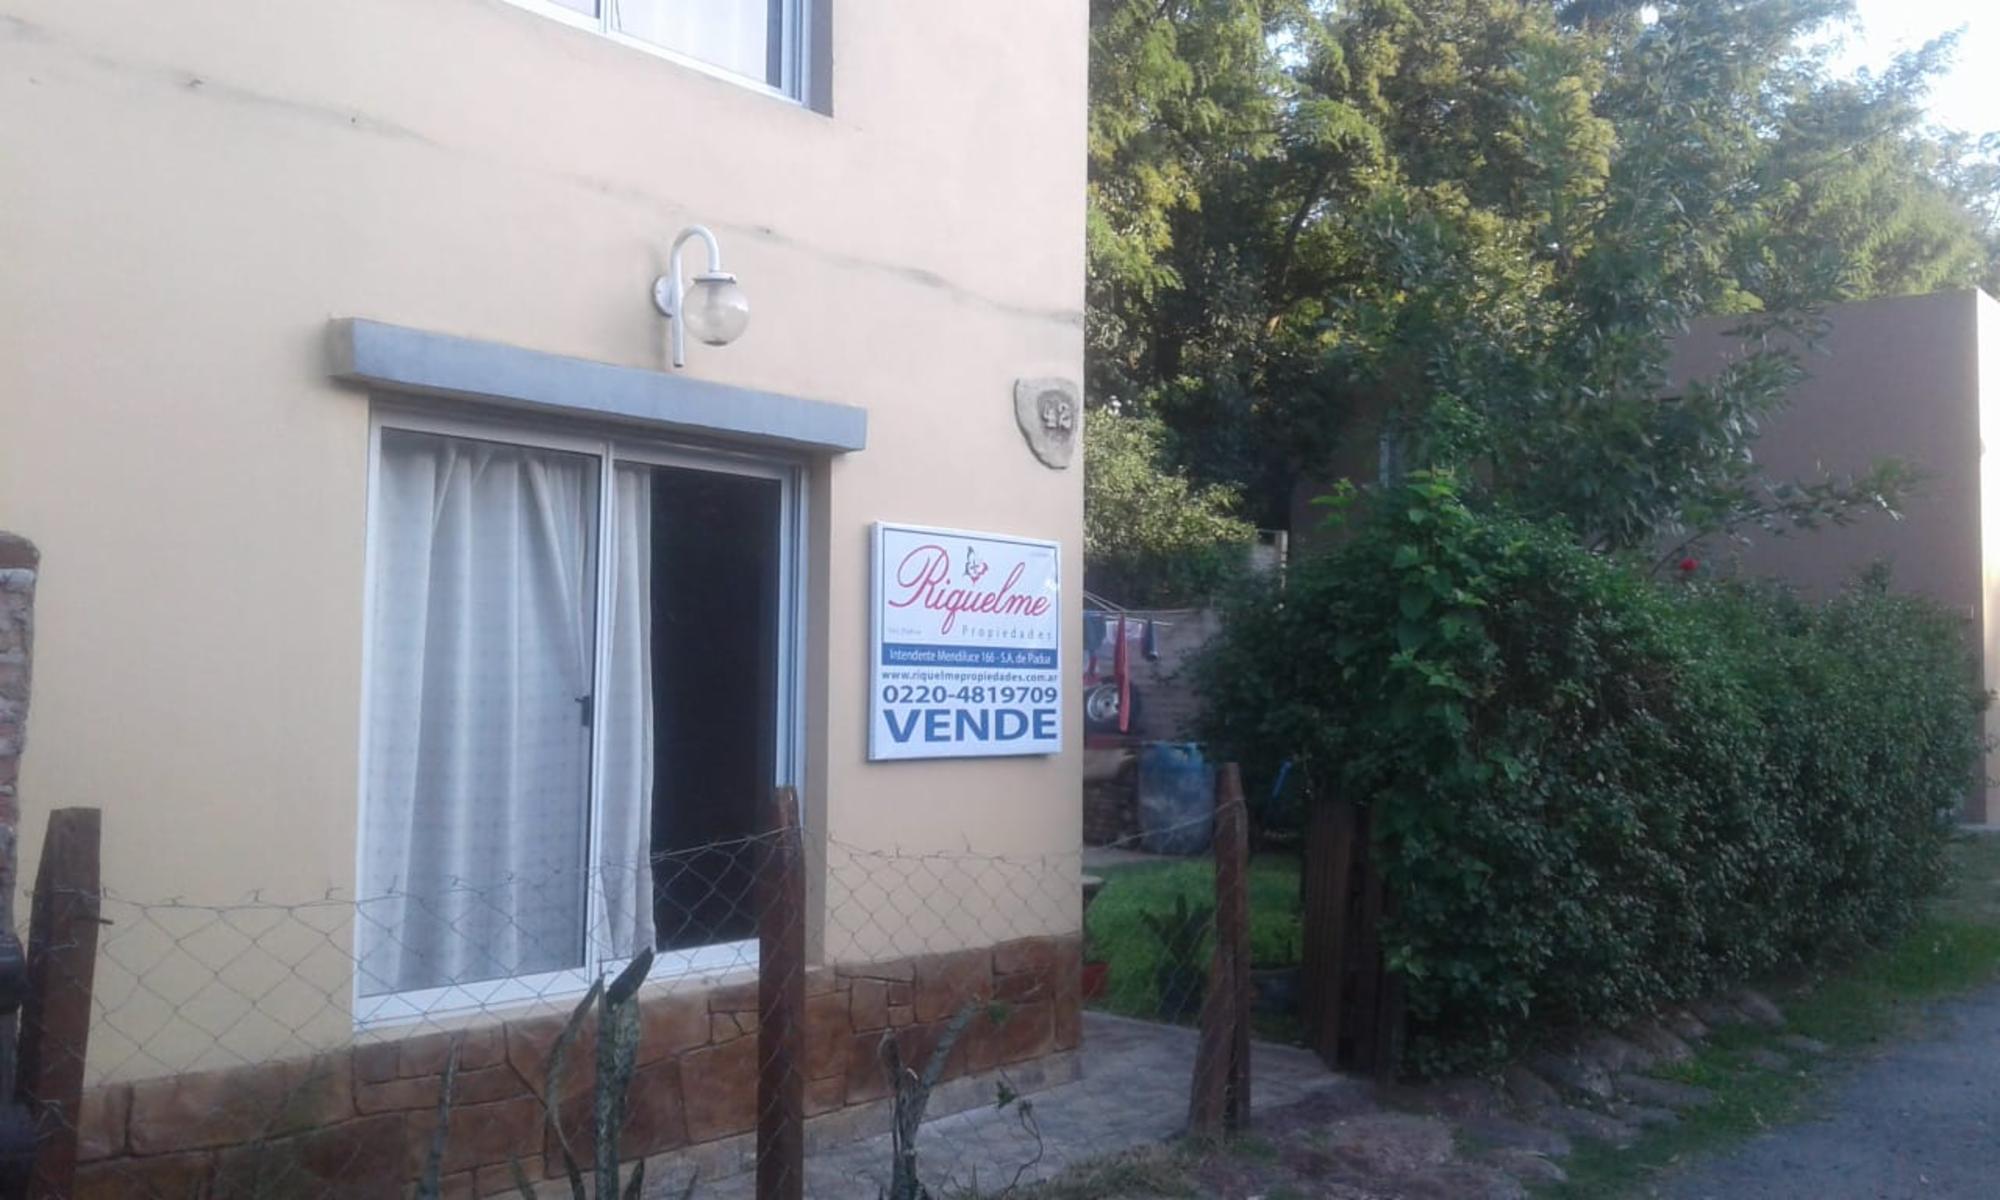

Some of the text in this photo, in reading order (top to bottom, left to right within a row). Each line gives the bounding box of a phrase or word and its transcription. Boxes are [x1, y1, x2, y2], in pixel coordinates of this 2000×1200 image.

[888, 545, 1050, 635] Riquelme
[962, 624, 1051, 640] Propiedades
[889, 649, 935, 662] Intendente
[1015, 652, 1027, 664] de
[881, 670, 1057, 683] www.riquelmepropiedades.com.ar
[882, 685, 1057, 704] 0220-4819709
[883, 708, 1057, 743] VENDE
